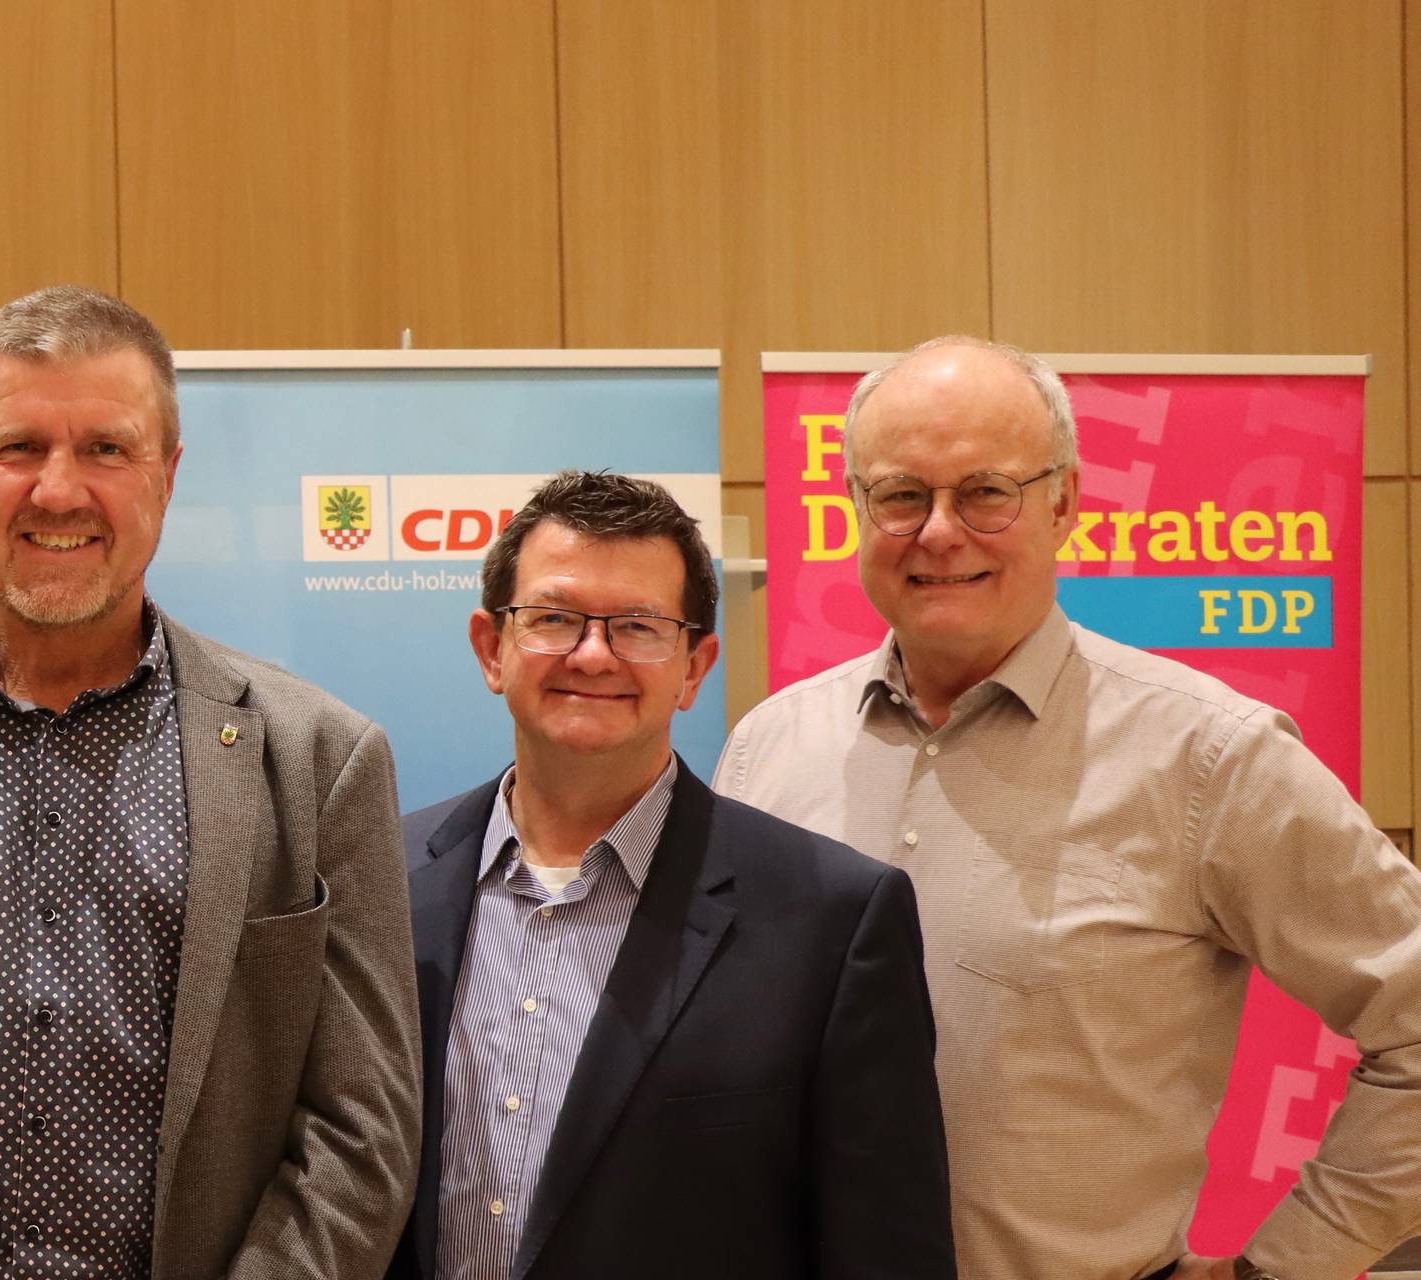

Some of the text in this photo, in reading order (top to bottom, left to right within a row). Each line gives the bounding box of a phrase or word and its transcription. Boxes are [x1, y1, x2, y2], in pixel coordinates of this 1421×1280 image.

[401, 508, 515, 552] CD
[801, 494, 1334, 563] Dkraten
[304, 569, 483, 593] www.cdu-holzwi
[1198, 589, 1316, 635] FDP
